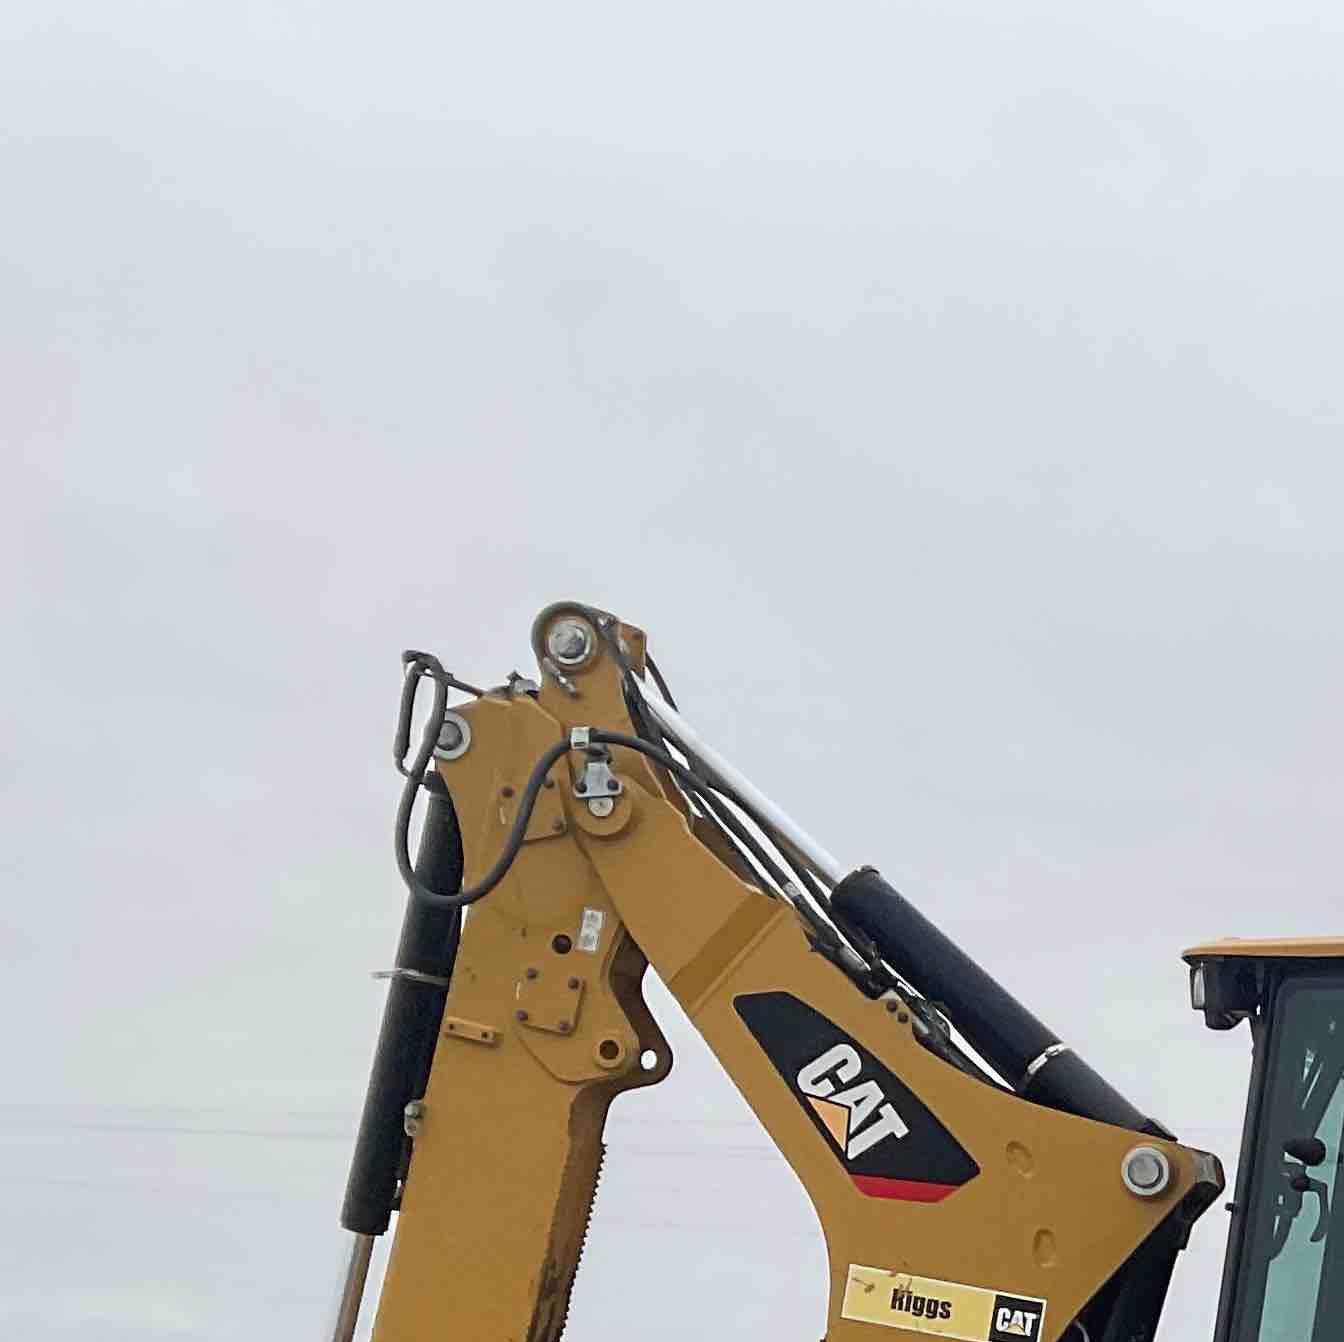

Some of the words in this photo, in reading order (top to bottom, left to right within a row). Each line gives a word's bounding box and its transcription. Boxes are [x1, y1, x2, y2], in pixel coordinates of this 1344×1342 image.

[797, 1043, 910, 1160] CAT
[890, 1288, 952, 1320] Riggs
[996, 1307, 1039, 1337] CAT
